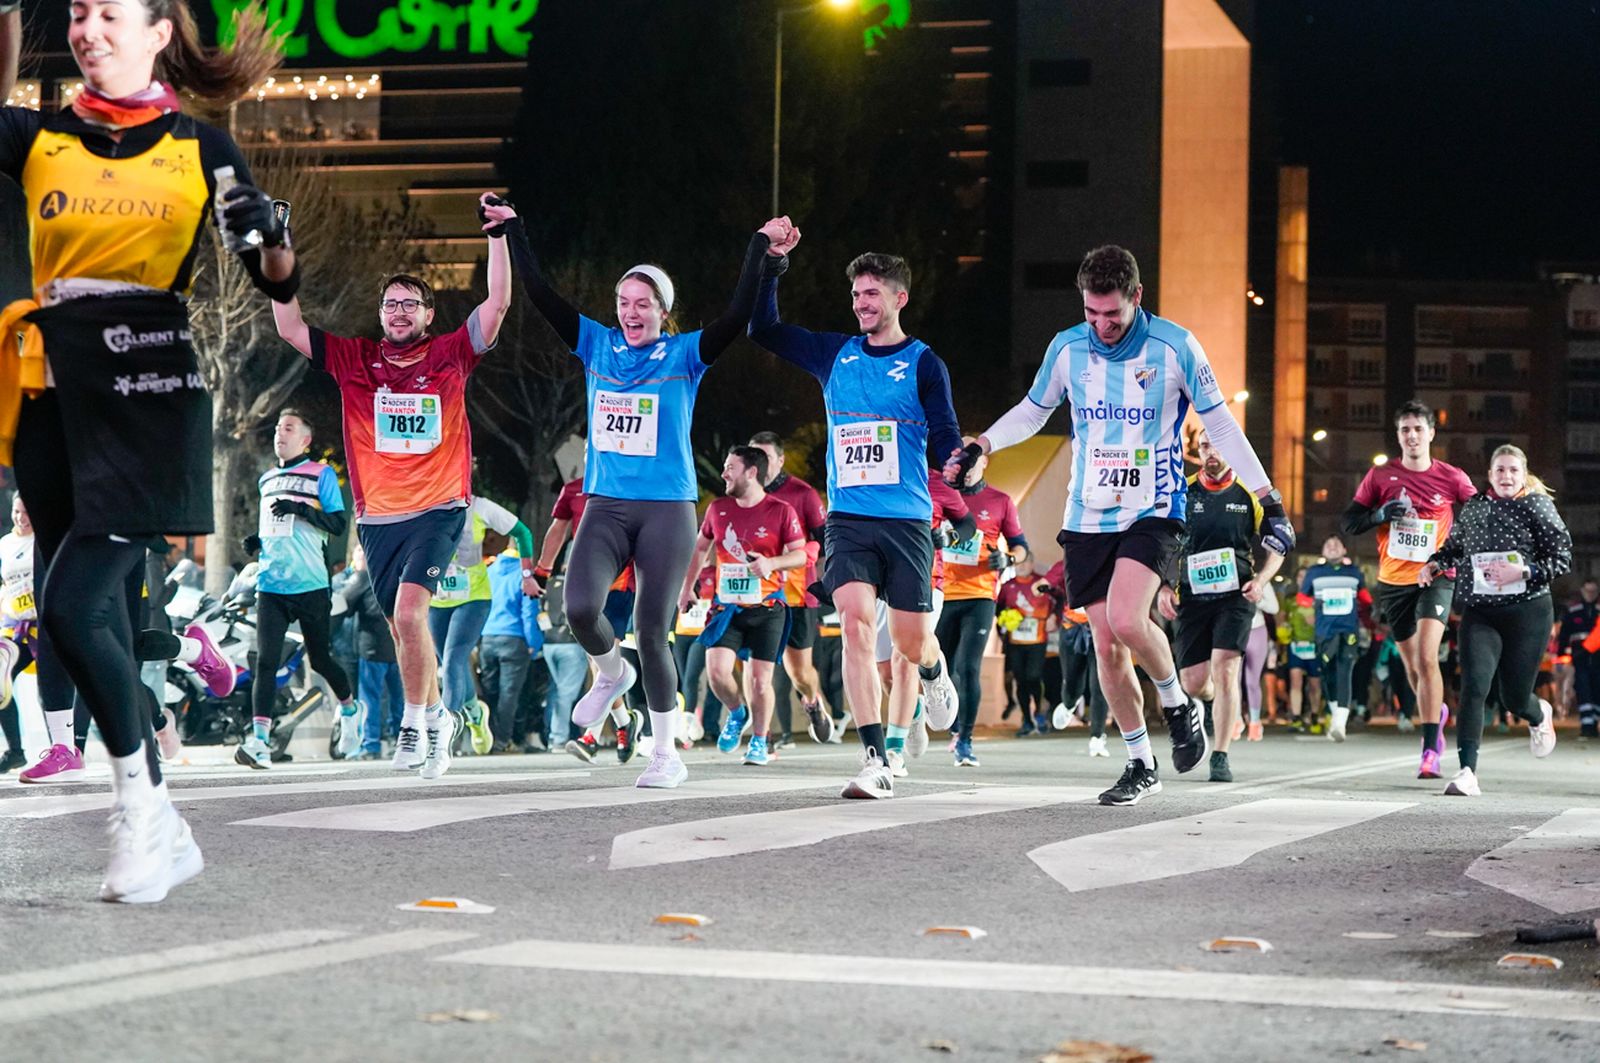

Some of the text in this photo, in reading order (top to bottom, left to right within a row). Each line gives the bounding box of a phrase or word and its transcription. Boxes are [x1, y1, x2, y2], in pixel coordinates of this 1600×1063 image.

[39, 190, 175, 223] AIRZONE
[388, 415, 426, 433] 7812
[606, 414, 642, 434] 2477
[845, 444, 884, 464] 2479
[1098, 468, 1141, 487] 2478
[1397, 532, 1428, 547] 3889
[1198, 565, 1228, 581] 9610
[728, 578, 750, 590] 1677
